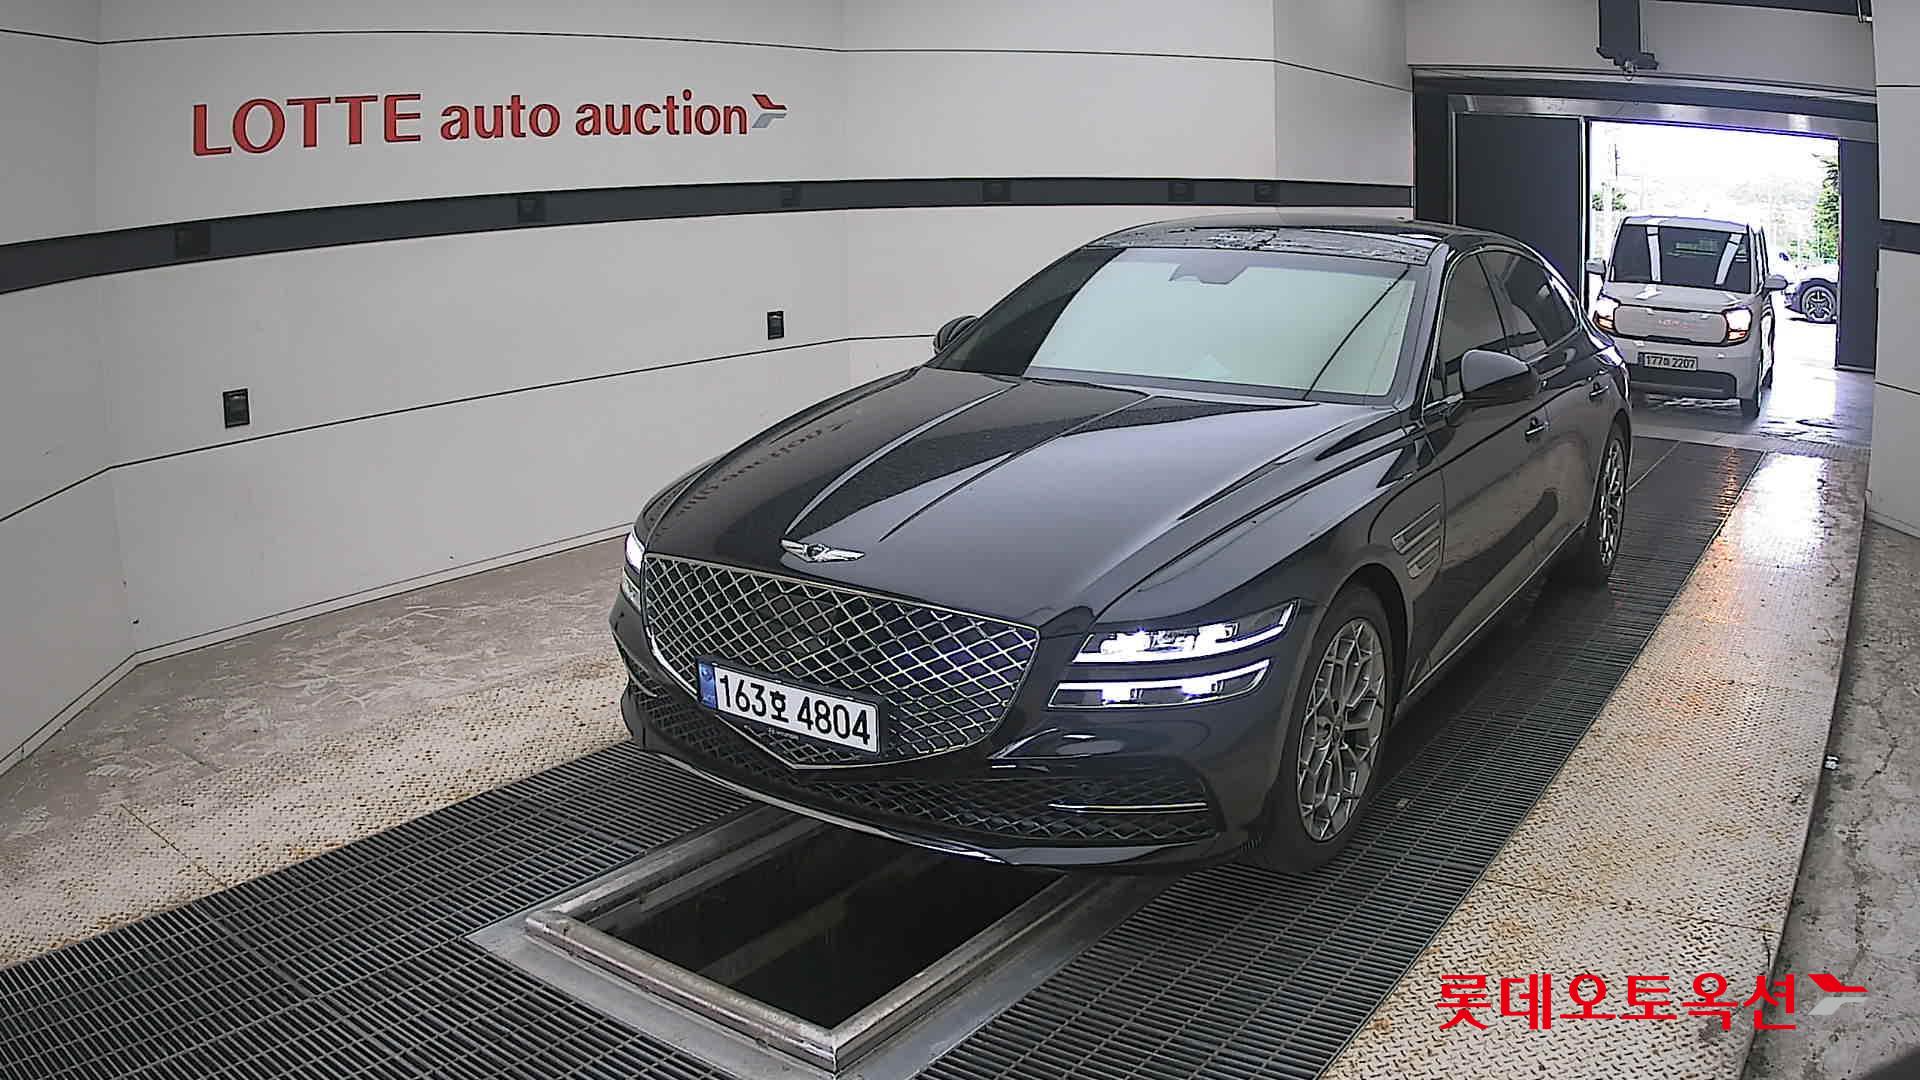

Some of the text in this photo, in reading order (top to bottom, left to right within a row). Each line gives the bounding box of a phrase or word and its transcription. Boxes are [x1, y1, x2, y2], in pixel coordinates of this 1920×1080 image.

[193, 89, 748, 156] LOTTE auto auction
[719, 674, 870, 745] 163호 4804
